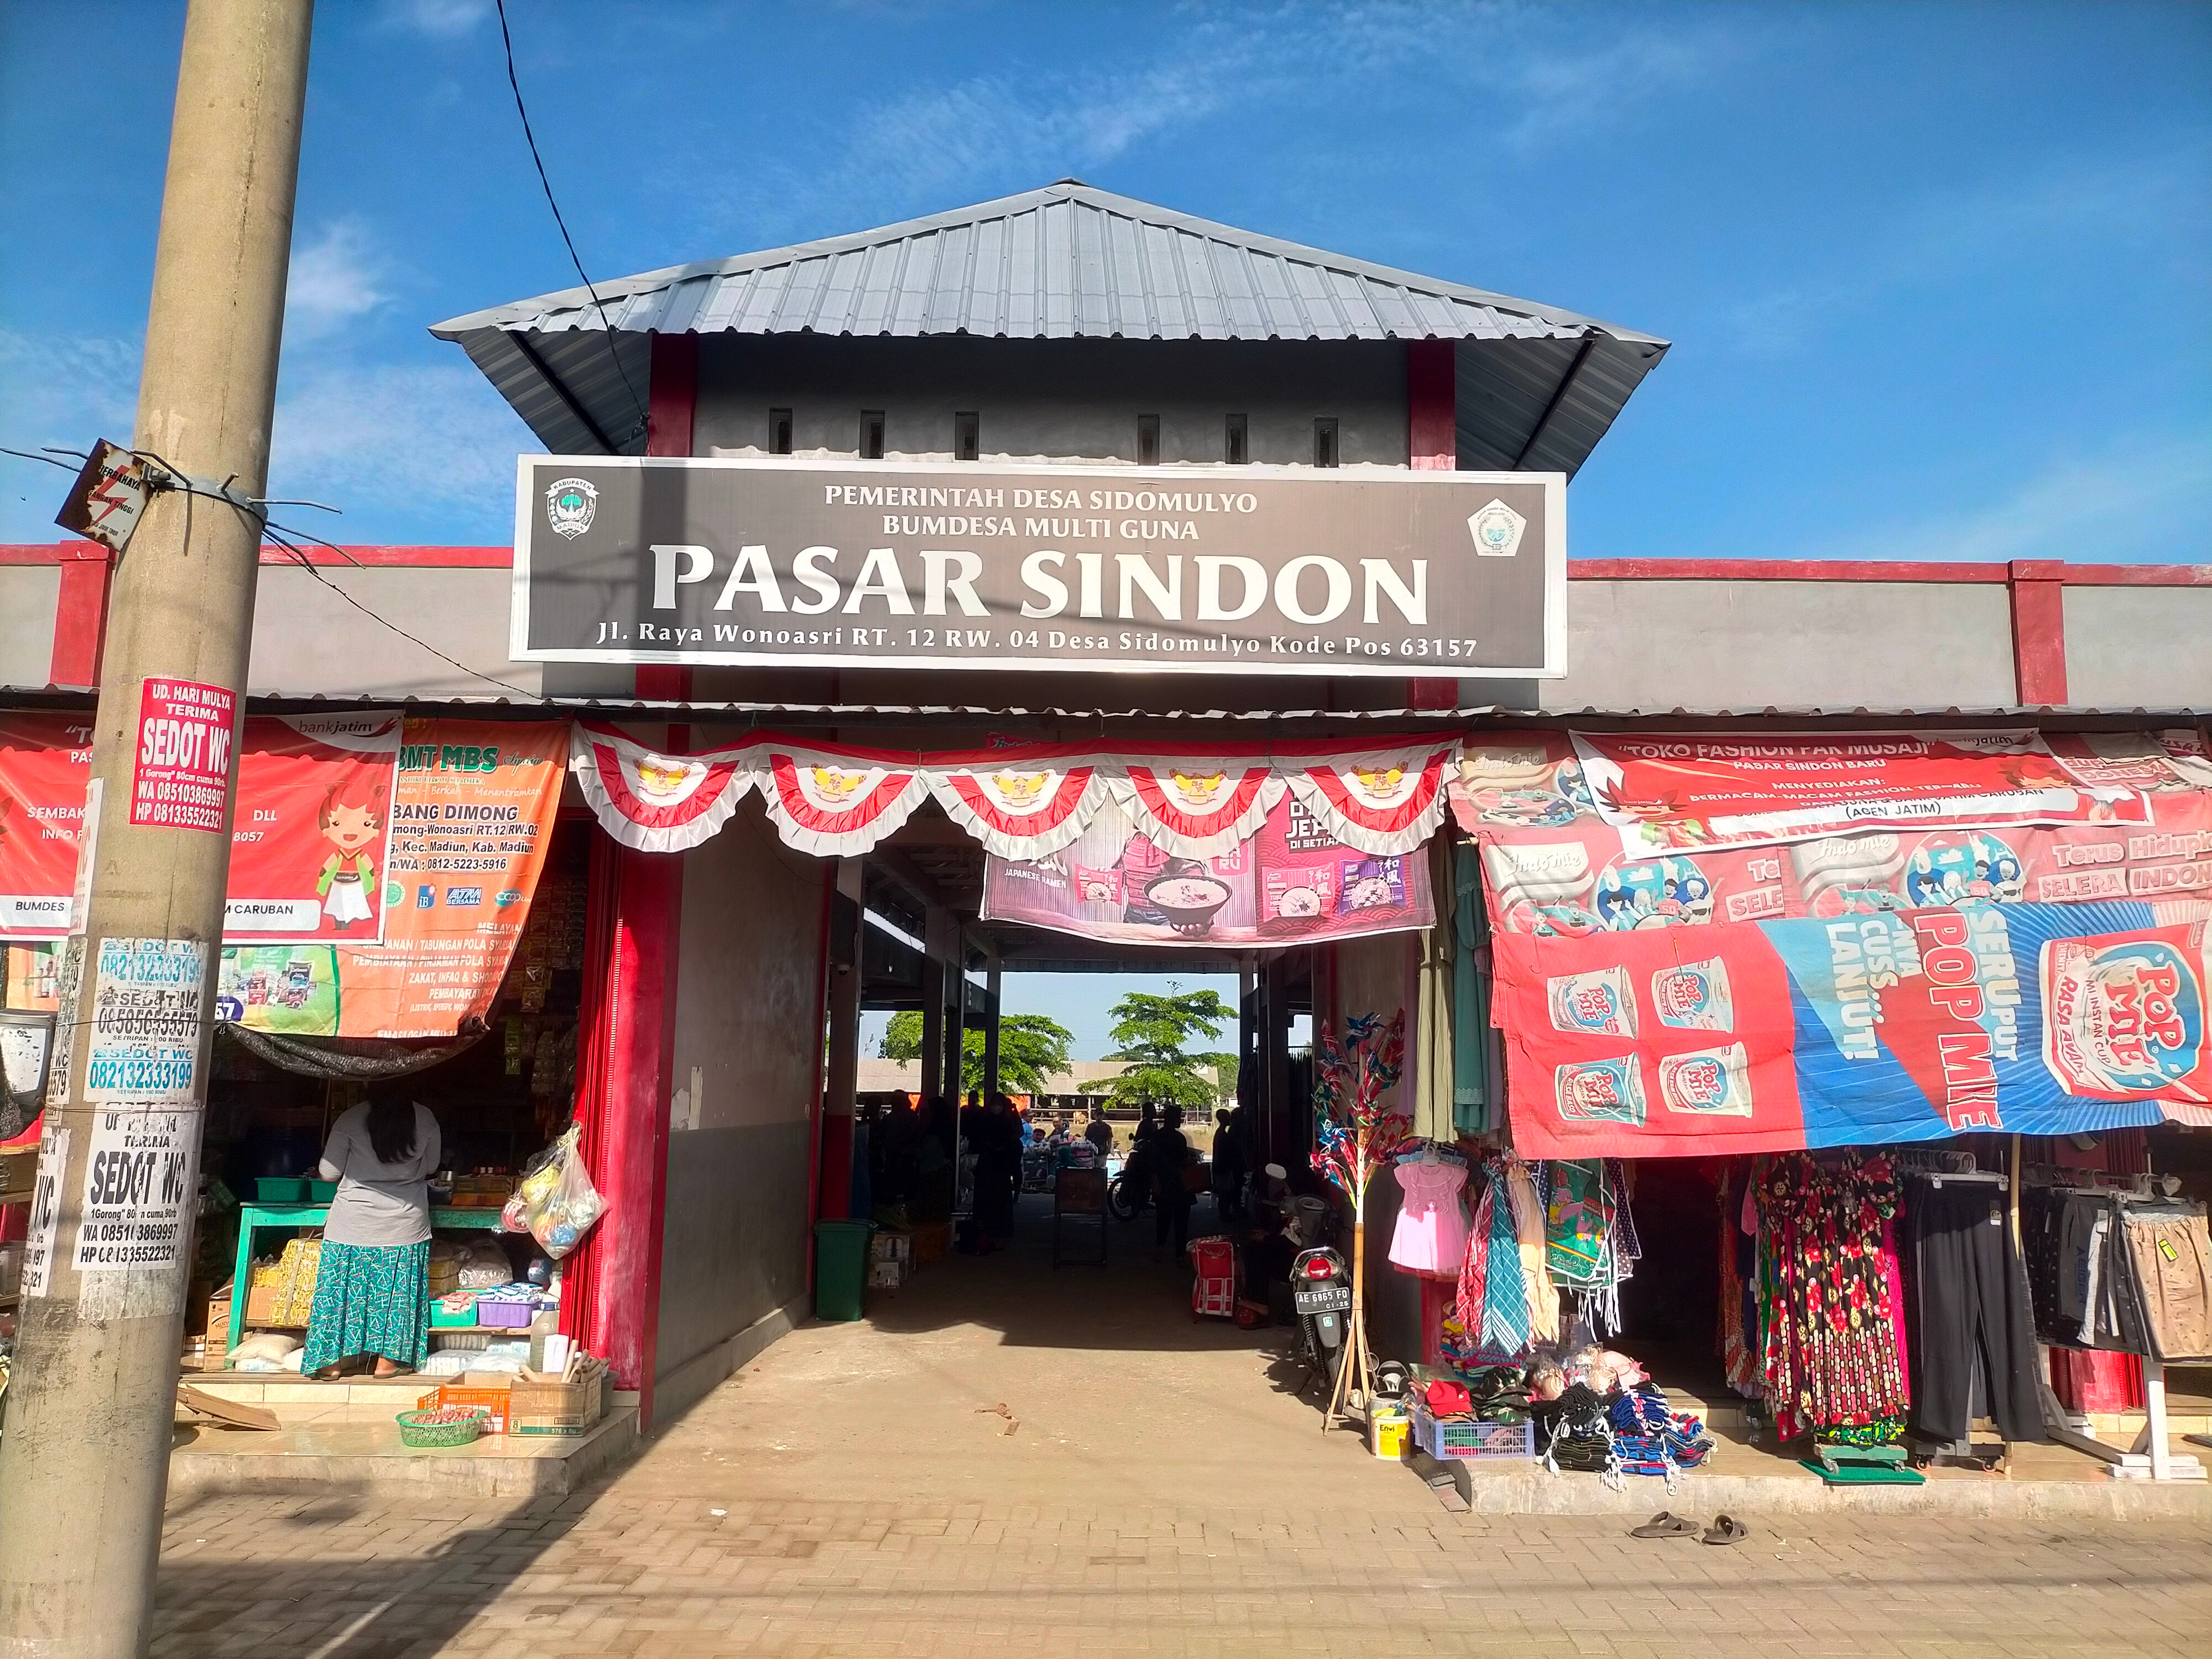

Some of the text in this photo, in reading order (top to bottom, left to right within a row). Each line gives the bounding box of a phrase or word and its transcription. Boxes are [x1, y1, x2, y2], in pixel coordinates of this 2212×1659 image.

[554, 480, 592, 489] KABUPATEN
[113, 500, 134, 514] TINGGI
[825, 486, 1257, 512] PEMERINTAH DESA SIDOMULYO
[883, 516, 1199, 539] BUMDESA MULTI GUNA
[650, 545, 1427, 624] PASAR SINDON
[597, 622, 1477, 656] Jl. Raya Wonoasri RT. 12 RW. 04 Desa Sidomulyo Kode Pos 63157
[153, 684, 230, 709] UD. HARI MULYA
[166, 703, 218, 722] TERIMA
[299, 718, 372, 735] bankjatim
[141, 718, 230, 775] SEDOT WC
[440, 744, 499, 773] MBS
[1733, 759, 1887, 771] PASAR SINDON BARU
[176, 771, 195, 781] 80cm
[196, 776, 213, 784] cuma
[1771, 778, 1886, 790] MENYEDIAKAN:
[138, 781, 225, 807] WA 085103869997
[431, 786, 461, 795] Berkah
[474, 787, 542, 797] Menentramkan
[1845, 785, 1913, 797] FASHION
[136, 802, 222, 829] HP 081335522321
[253, 810, 277, 822] DLL
[394, 805, 518, 820] BANG DIMONG
[1896, 801, 1941, 815] JATIM)
[42, 830, 73, 840] INFO
[233, 831, 264, 842] 8057
[393, 824, 473, 837] mong-Wonoasri
[403, 841, 427, 852] Kec.
[430, 842, 468, 853] Madiun,
[472, 842, 496, 852] Kab.
[499, 842, 534, 853] Madiun
[1290, 841, 1300, 849] DI
[2055, 831, 2212, 865] Terus Hidupk
[427, 859, 507, 869] 0812-5223-5916
[1004, 868, 1067, 889] JAPANESE RAMEN
[2043, 874, 2123, 898] SELERA
[448, 888, 481, 899] ATM
[15, 901, 293, 915] BUMDES CARUBAN
[420, 940, 486, 951] TABUNGAN POLA
[460, 956, 484, 967] POLA
[438, 972, 460, 983] INFAQ
[1969, 910, 2018, 1061] SERUPUT
[1673, 983, 1692, 1008] MIE
[1684, 976, 1703, 1002] POP
[1827, 922, 1880, 1061] LANJUT!
[1576, 993, 1599, 1020] MIE
[1587, 987, 1610, 1014] POP
[2059, 976, 2079, 1025] RASA
[2139, 963, 2184, 1047] POP
[1914, 913, 2004, 1131] POP MIE
[2087, 980, 2112, 1063] MI INSTAN CUP
[2106, 983, 2156, 1066] MIE
[173, 1050, 193, 1060] WC
[90, 1061, 192, 1089] 082132333199
[1700, 1063, 1721, 1092] POP
[1596, 1074, 1618, 1103] POP
[1688, 1071, 1711, 1099] MIE
[1566, 1095, 1575, 1113] BASO
[91, 1151, 186, 1204] SEDOT WC
[165, 1209, 177, 1218] 90rb
[84, 1224, 97, 1241] WA
[80, 1247, 97, 1262] HP
[1299, 1294, 1310, 1303] AE
[513, 1420, 518, 1428] 8
